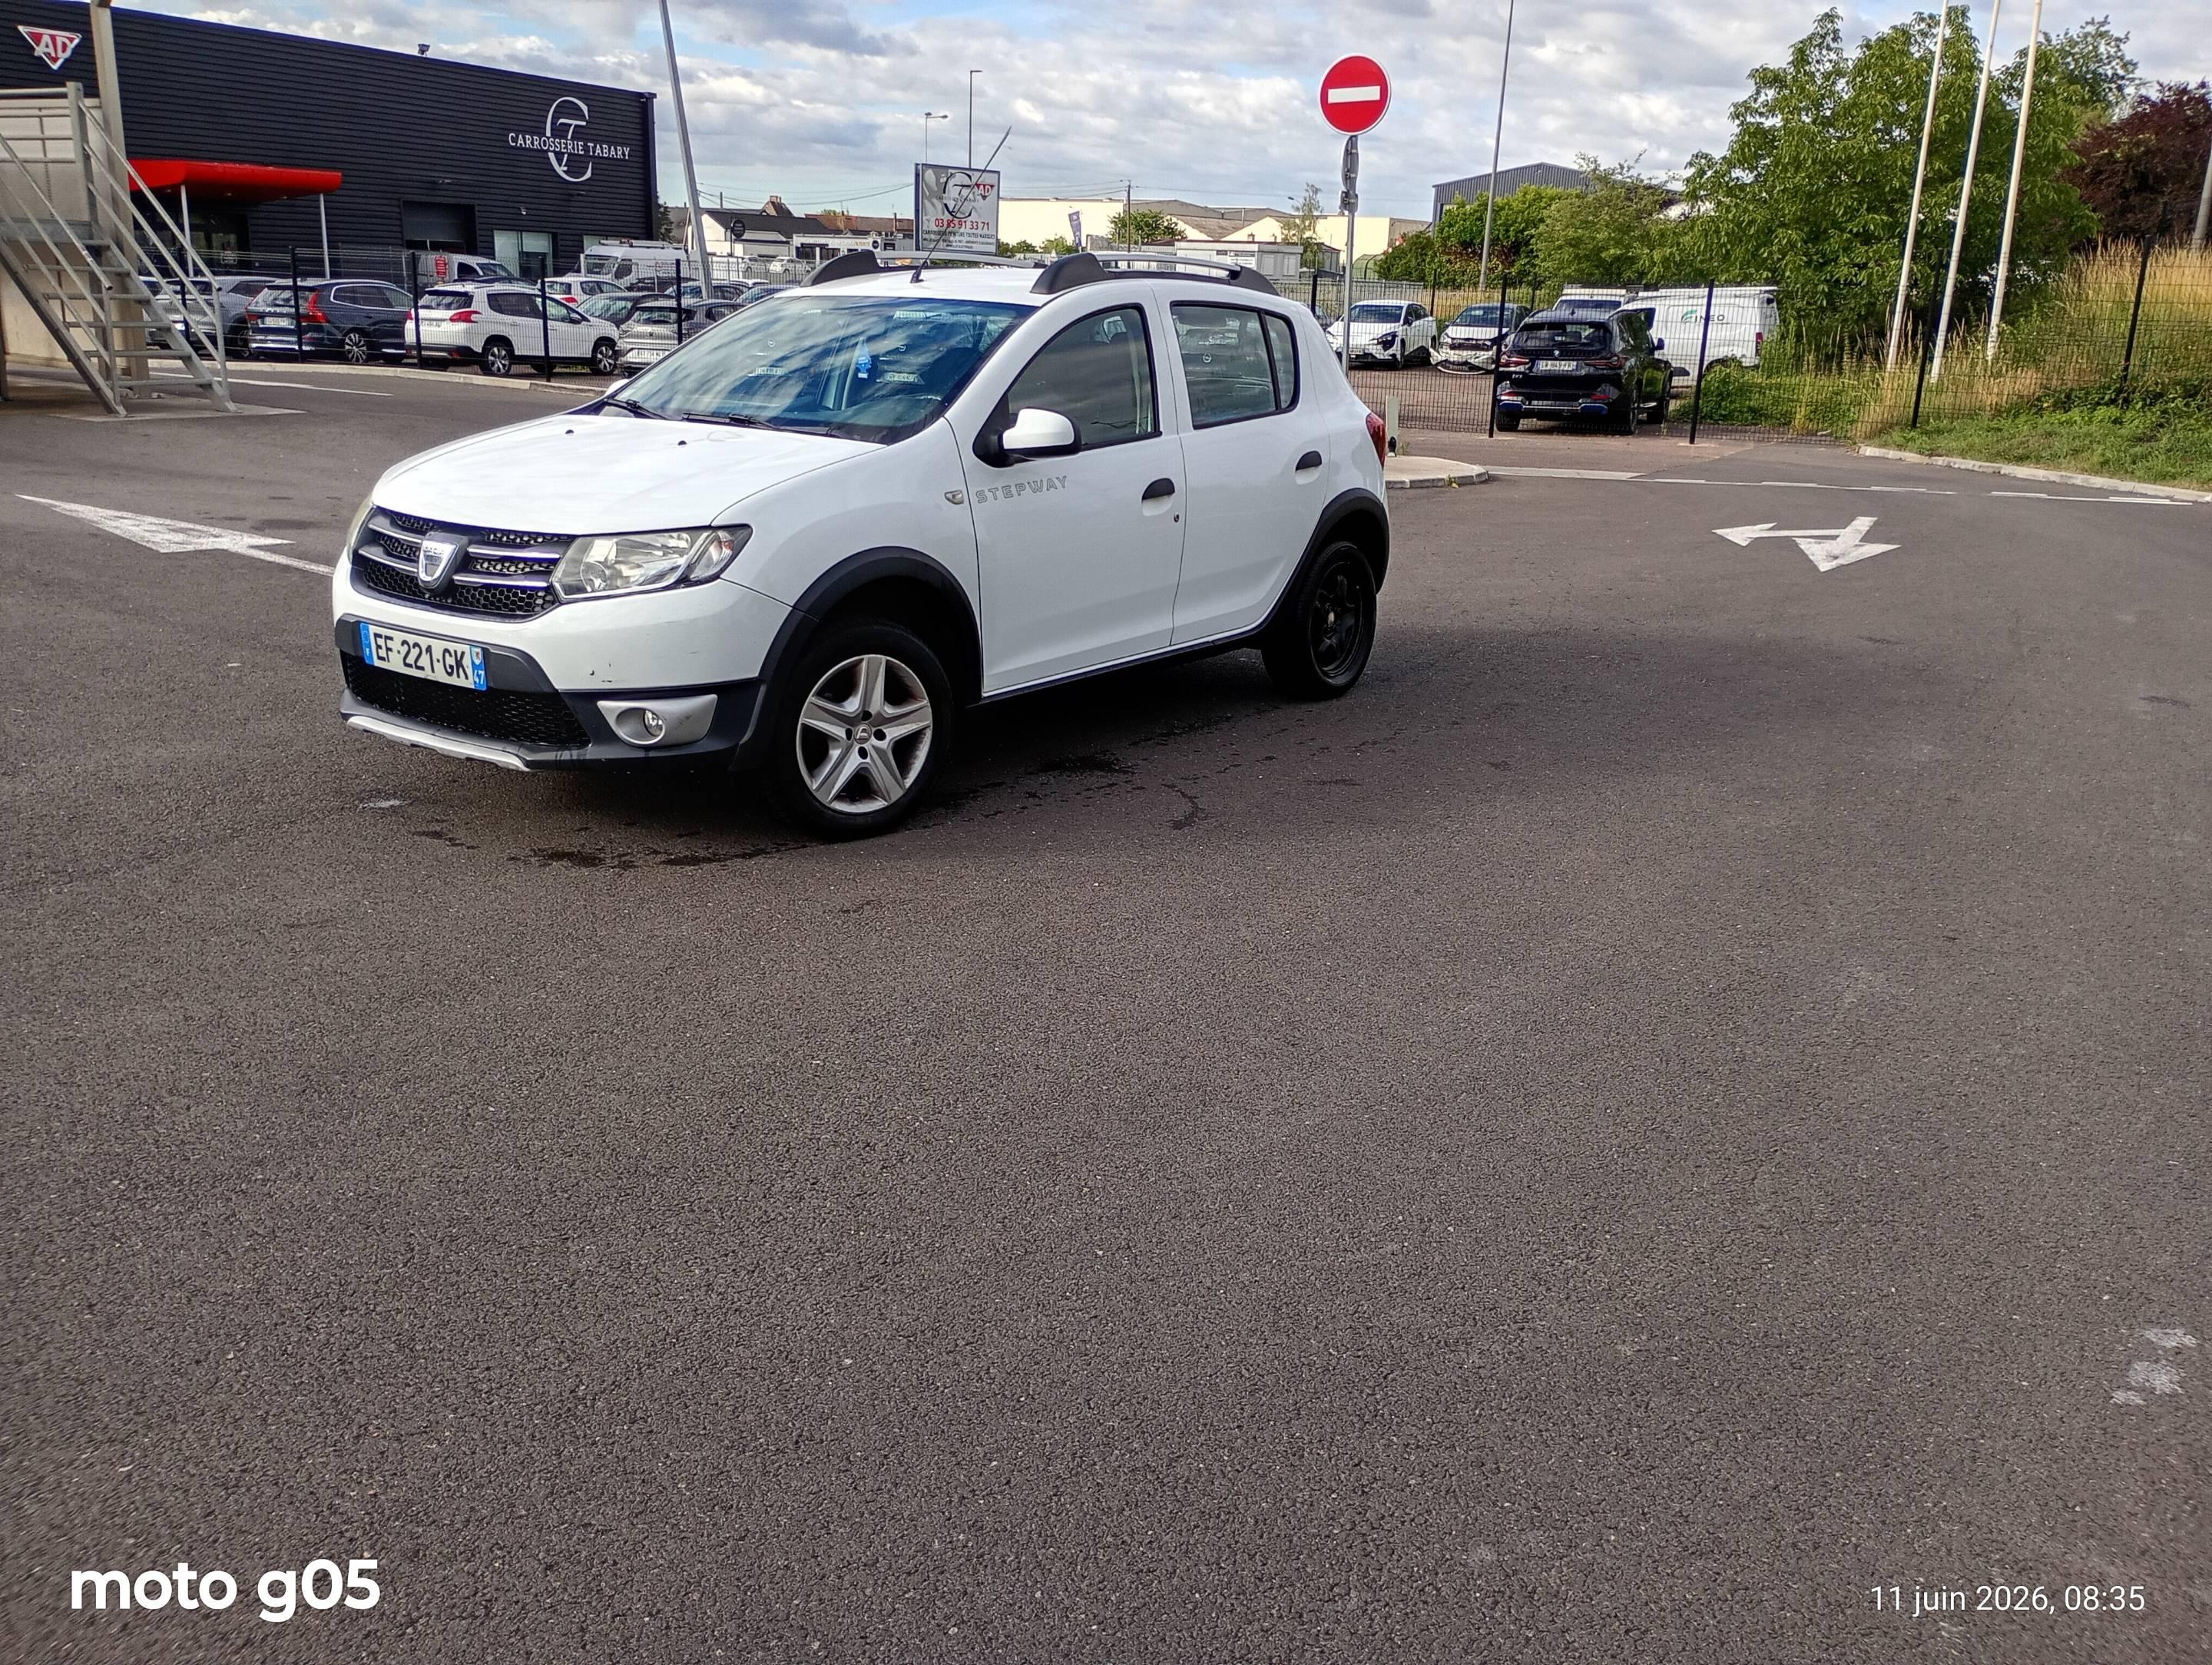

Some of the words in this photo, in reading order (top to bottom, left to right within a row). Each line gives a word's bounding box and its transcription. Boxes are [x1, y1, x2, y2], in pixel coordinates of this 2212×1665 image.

[34, 34, 72, 58] AD
[508, 132, 584, 154] CARROSSERIE
[588, 142, 630, 160] TABARY
[979, 185, 992, 197] AD
[935, 218, 945, 227] 03
[946, 219, 956, 228] 85
[958, 220, 967, 229] 91
[970, 220, 979, 230] 33
[981, 221, 989, 231] 71
[975, 475, 1067, 504] STEPWAY
[373, 632, 469, 680] EF-221-GK
[473, 669, 485, 685] 47
